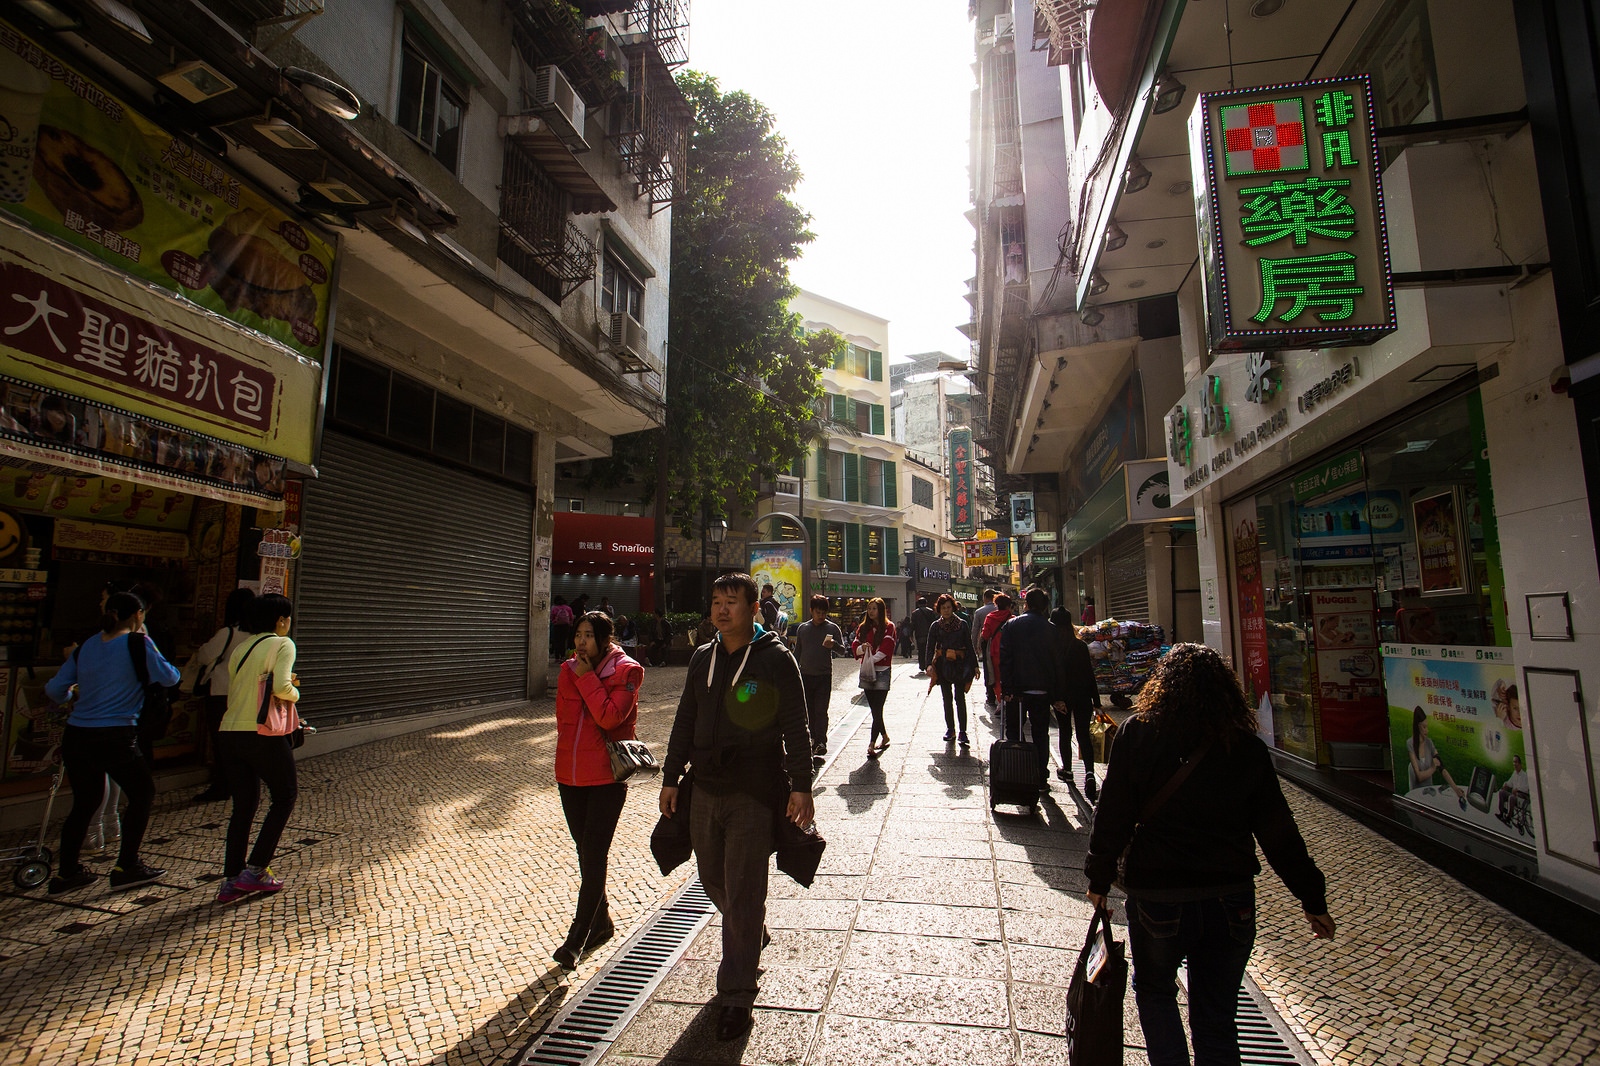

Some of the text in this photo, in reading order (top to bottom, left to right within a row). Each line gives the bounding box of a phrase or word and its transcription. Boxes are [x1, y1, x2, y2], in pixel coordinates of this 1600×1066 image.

[4, 290, 263, 421] 大聖豬扒包
